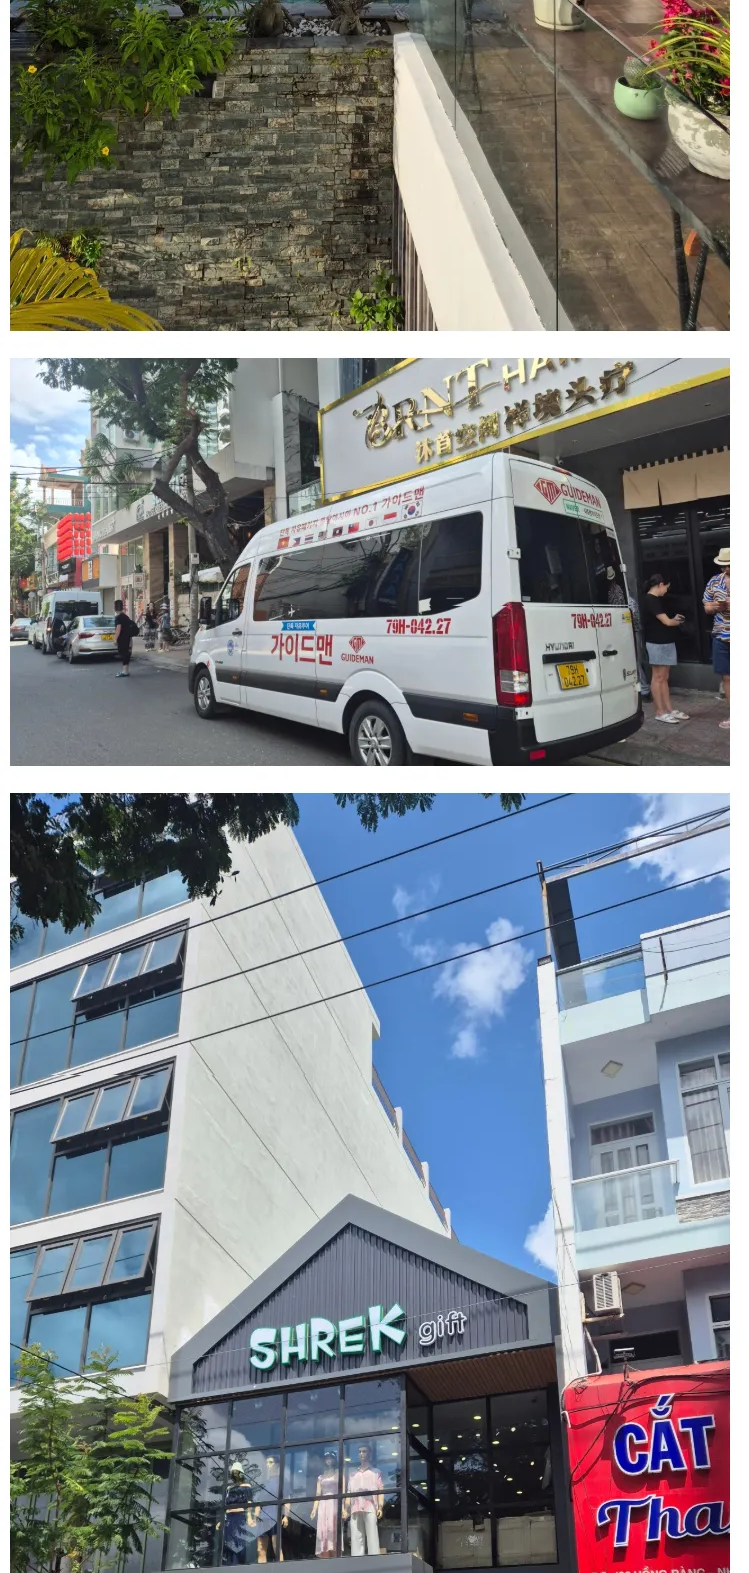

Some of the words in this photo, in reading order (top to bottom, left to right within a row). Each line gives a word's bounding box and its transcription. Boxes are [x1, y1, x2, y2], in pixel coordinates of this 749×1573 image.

[381, 486, 425, 508] 가이드맨
[560, 483, 602, 509] GUIDEMAN
[386, 618, 452, 635] 79H-042.27
[571, 612, 613, 629] 79H-042.27
[270, 633, 334, 666] 가이드맨
[340, 653, 374, 665] GUIDEMAN
[565, 665, 579, 675] 79H
[249, 1302, 407, 1371] SHREK
[418, 1310, 468, 1347] gift
[613, 1393, 716, 1476] CẮT
